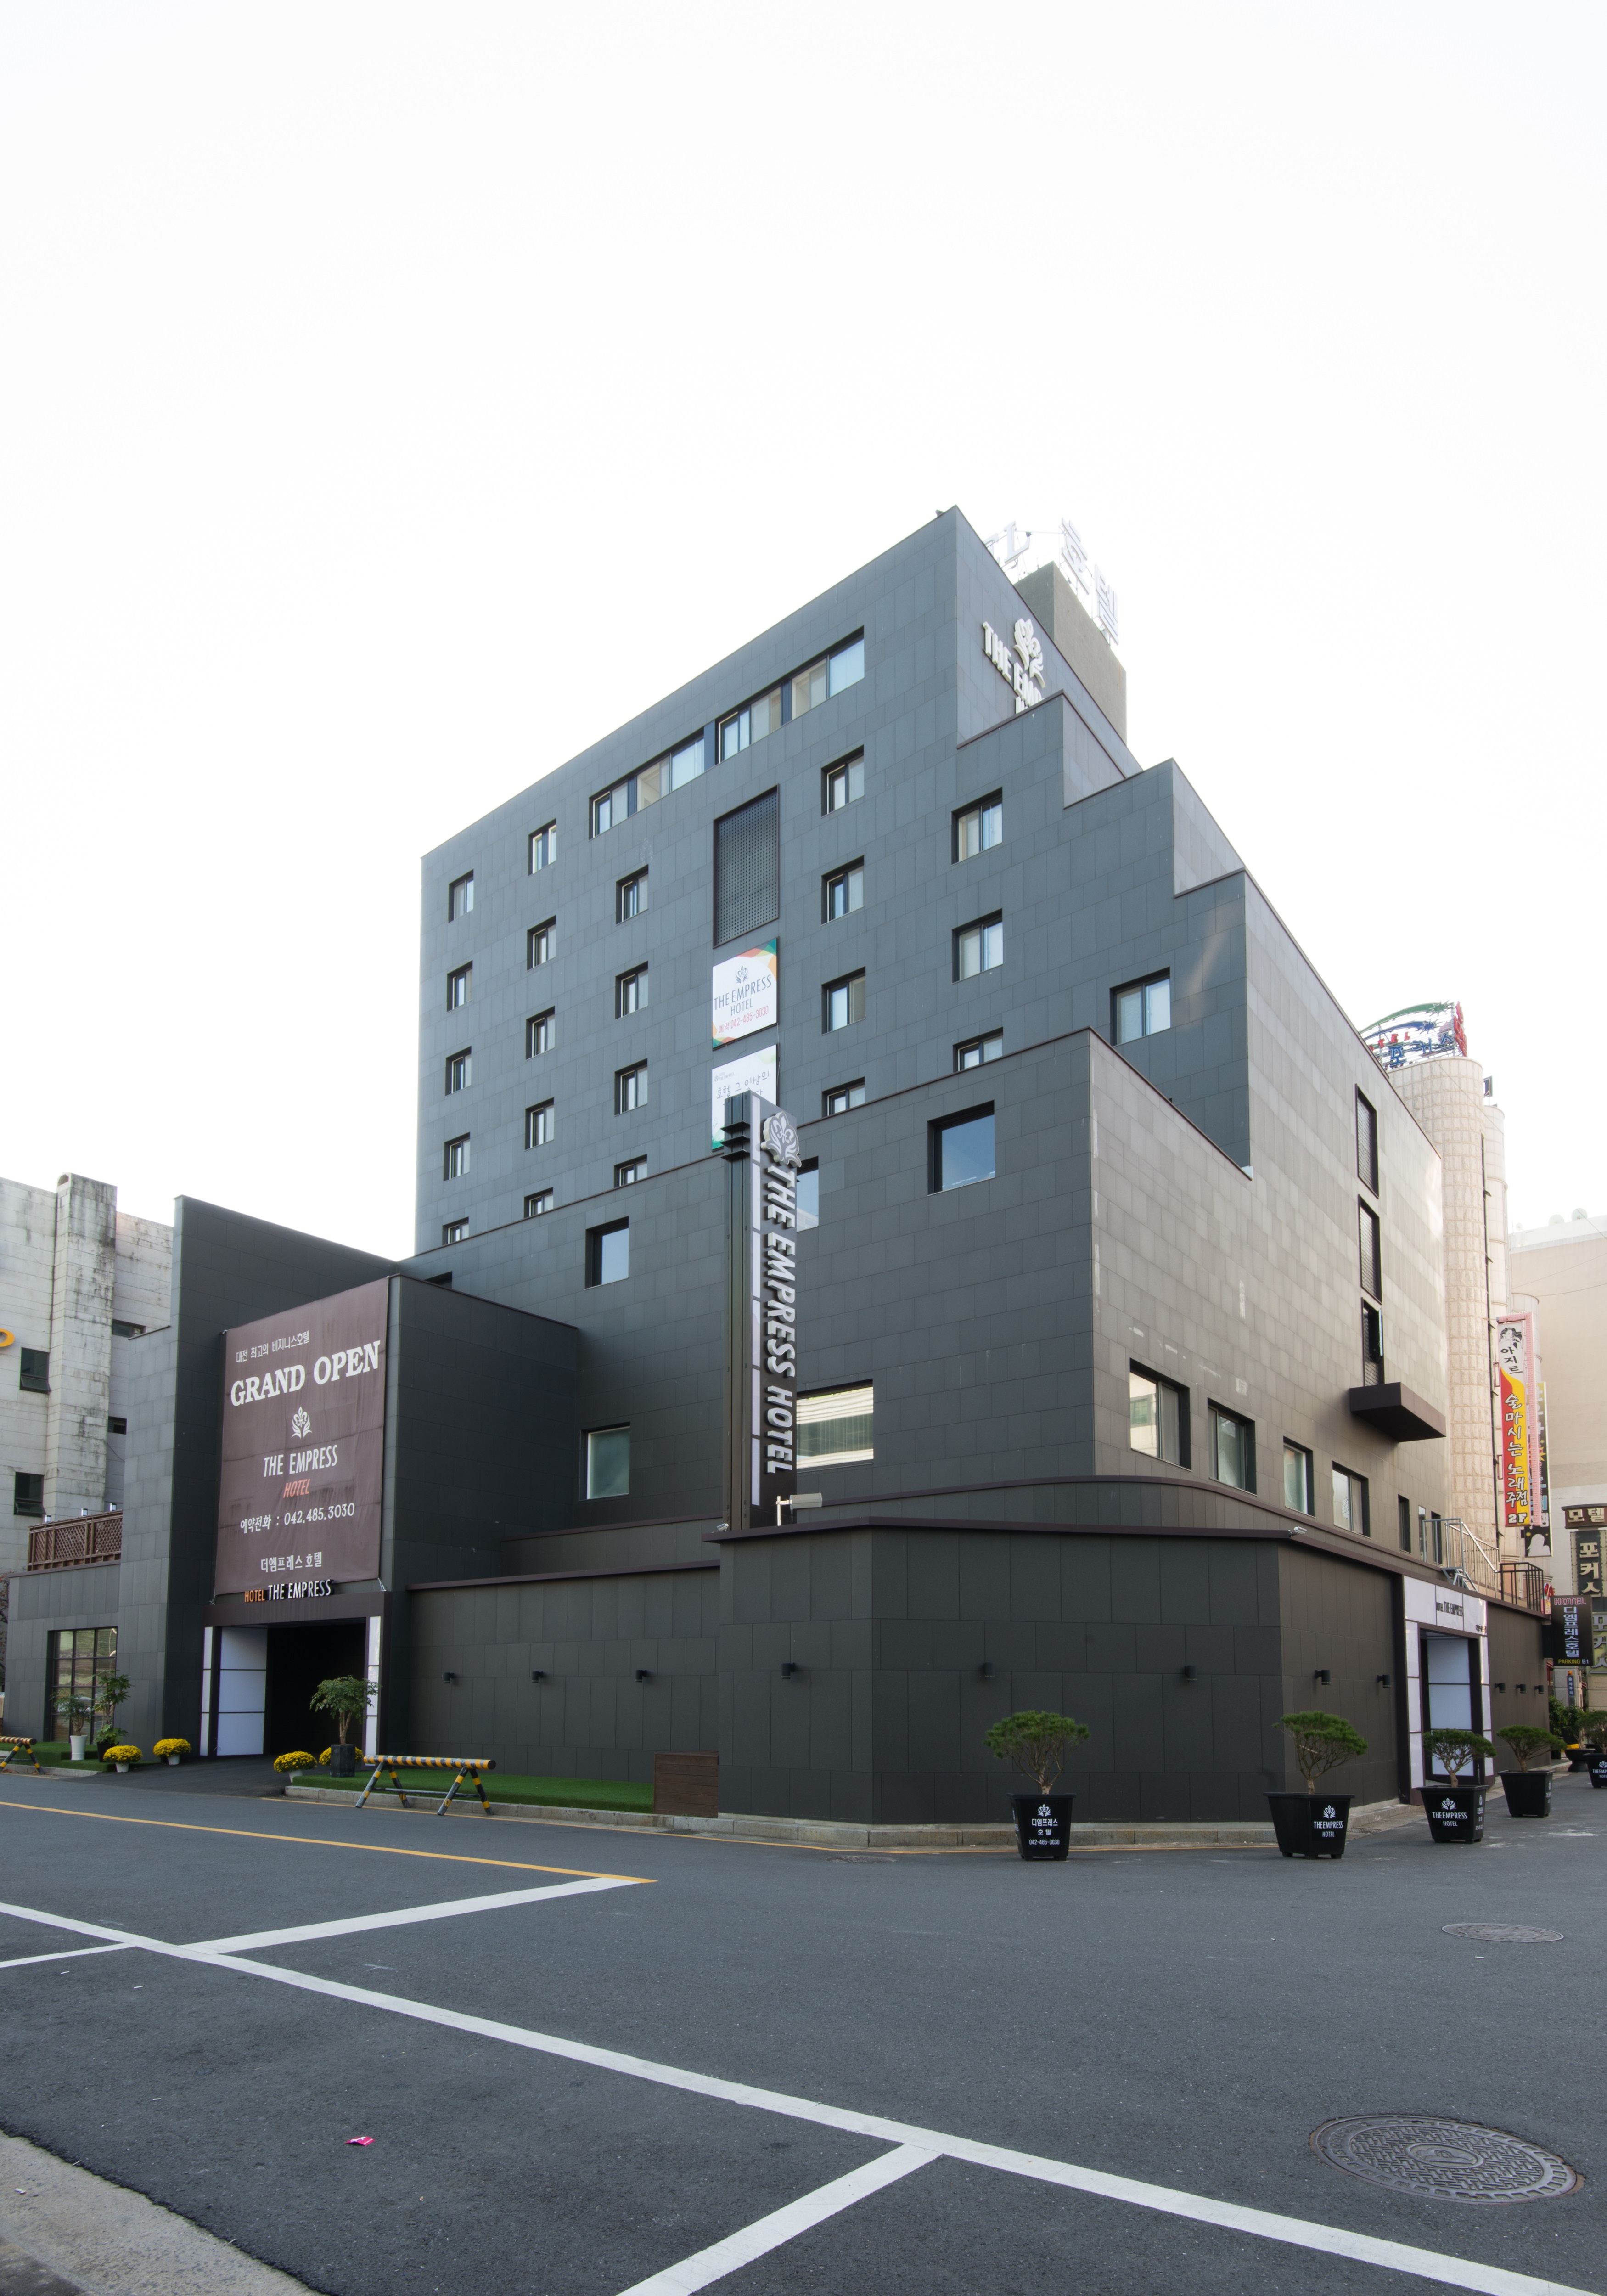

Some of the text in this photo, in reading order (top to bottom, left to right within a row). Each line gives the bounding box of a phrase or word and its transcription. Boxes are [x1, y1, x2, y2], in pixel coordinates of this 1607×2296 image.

[983, 621, 1011, 681] THE
[714, 974, 771, 1010] THE EMPRESS
[719, 1005, 769, 1033] 예약 042-485-3030
[730, 998, 753, 1016] HOTEL
[717, 1084, 731, 1099] 호텔
[735, 1082, 742, 1092] 그
[745, 1070, 769, 1086] 이상의
[767, 1165, 795, 1473] THE EMPRESS HOTEL
[236, 1330, 309, 1363] 대전 최고의 비지니스호텔
[1500, 1346, 1523, 1374] 아지트
[230, 1340, 381, 1407] GRAND OPEN
[264, 1444, 338, 1477] THE EMPRESS
[1504, 1393, 1528, 1508] 술마시는 노래주점
[283, 1479, 310, 1498] HOTEL
[240, 1514, 271, 1534] 예약전화
[284, 1503, 354, 1525] 042.485.3030
[1508, 1513, 1528, 1524] 2F
[1568, 1508, 1605, 1523] 모텔
[260, 1551, 322, 1573] 더엠프레스 호텔
[1579, 1542, 1601, 1597] 포커스
[245, 1579, 331, 1602] HOTEL THE EMPRESS
[1554, 1597, 1586, 1605] HOTEL
[1563, 1606, 1579, 1657] 디엠프레스호텔
[1032, 1818, 1058, 1827] 디엠프레스
